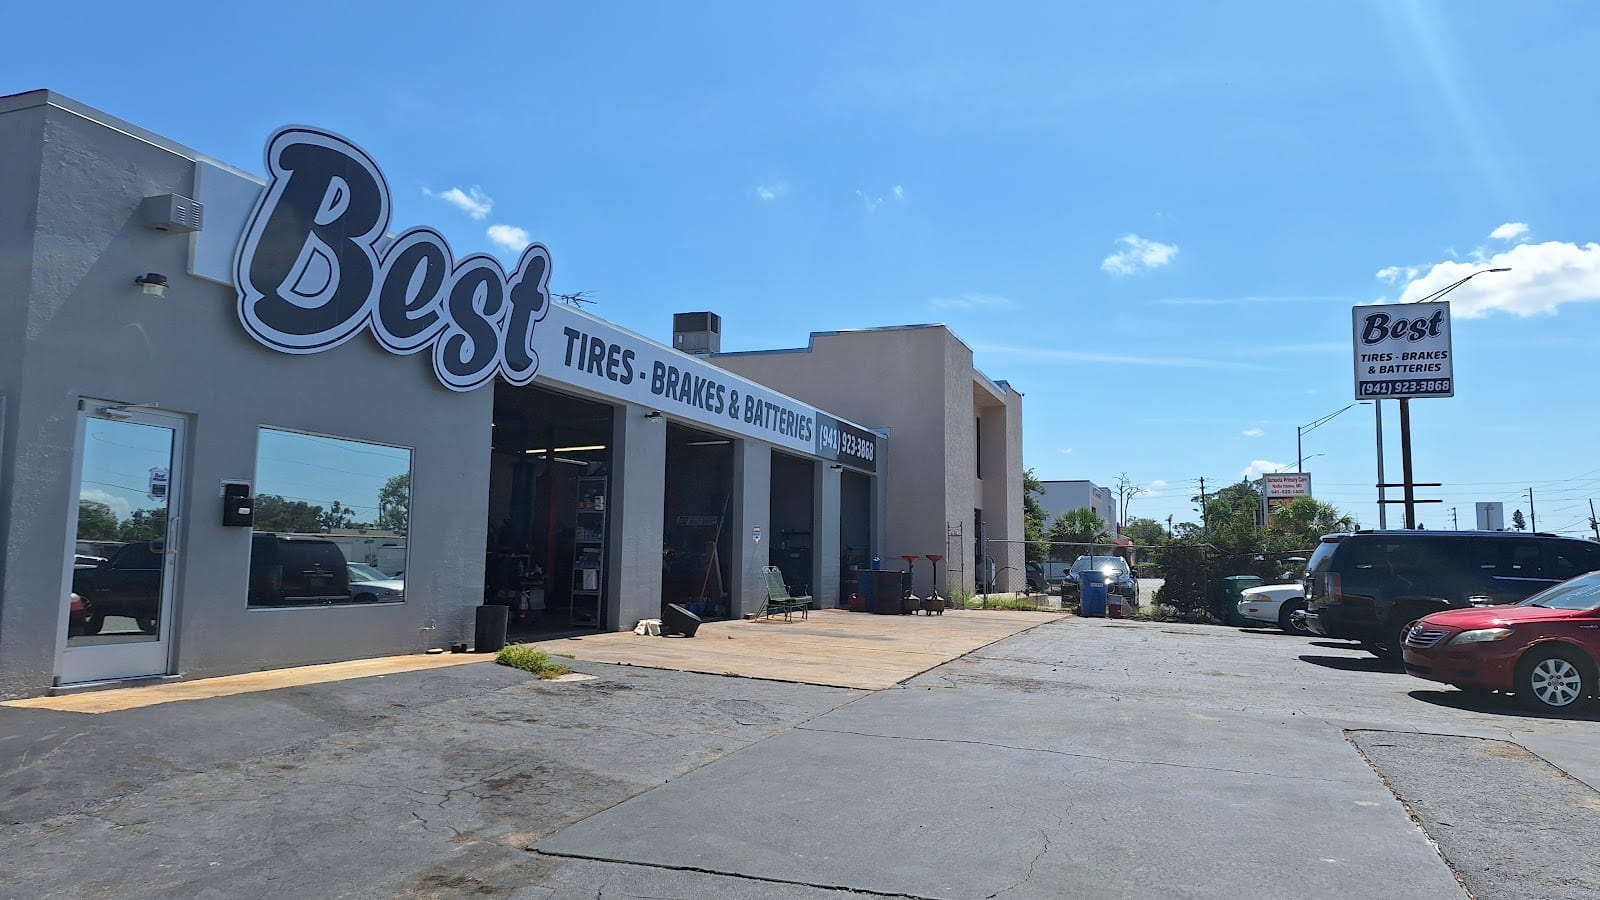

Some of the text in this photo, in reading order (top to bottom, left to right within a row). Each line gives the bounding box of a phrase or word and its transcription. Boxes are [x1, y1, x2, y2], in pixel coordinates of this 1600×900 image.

[239, 128, 549, 389] Best
[1361, 309, 1444, 346] Best
[1361, 353, 1392, 362] TIRES
[1402, 351, 1448, 360] BRAKES
[1368, 363, 1441, 374] & BATTERIES
[563, 326, 635, 385] TIRES
[651, 360, 725, 415] BRAKES
[728, 388, 740, 420] &
[744, 394, 812, 442] BATTERIES
[1362, 381, 1449, 394] (941) 923-3868
[819, 424, 874, 461] (941) 923-3868
